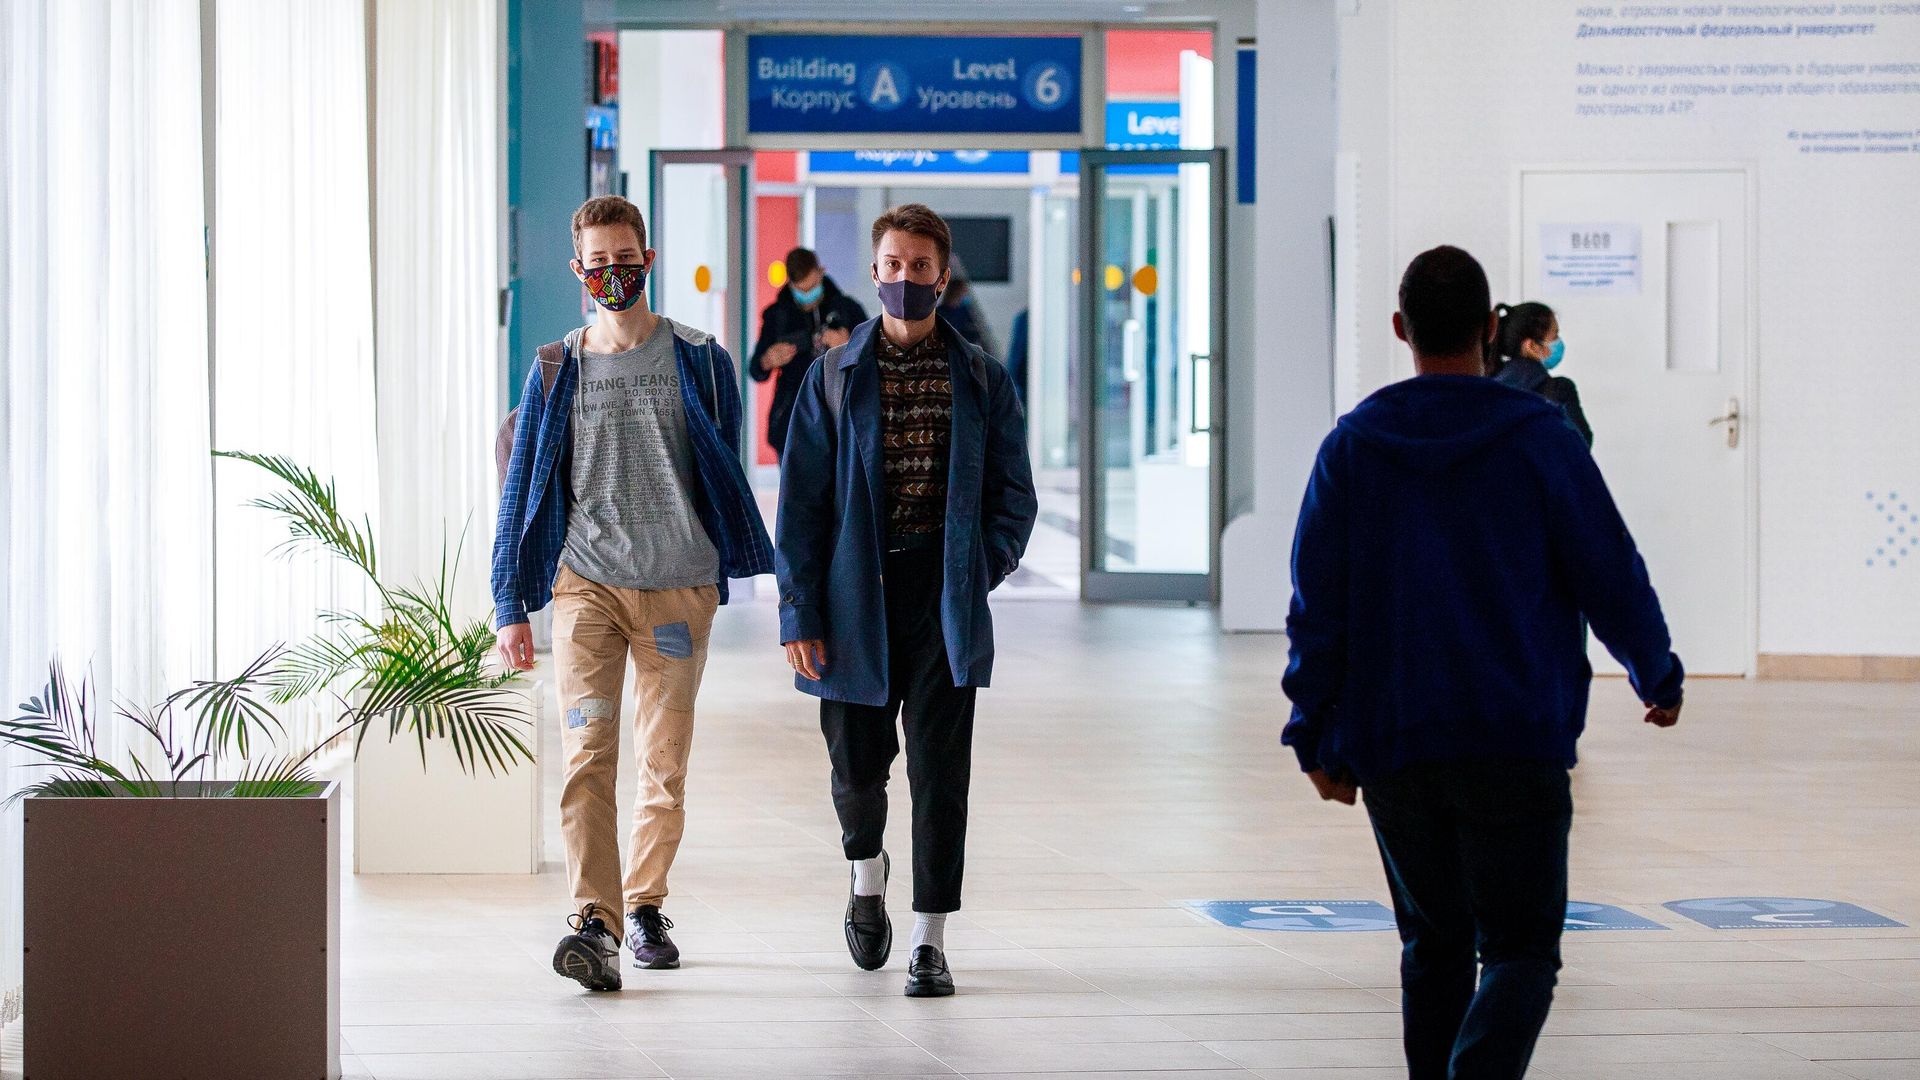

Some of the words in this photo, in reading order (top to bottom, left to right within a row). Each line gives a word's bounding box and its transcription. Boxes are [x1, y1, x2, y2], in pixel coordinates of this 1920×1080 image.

[1701, 22, 1792, 37] федеральный
[758, 56, 857, 85] Building
[952, 56, 1017, 81] Level
[869, 65, 901, 104] A
[1034, 66, 1062, 105] 6
[770, 86, 857, 114] Корпус
[916, 86, 1018, 114] Уровень
[624, 388, 641, 398] P.O.
[645, 387, 663, 397] BOX
[666, 388, 678, 398] 32
[631, 374, 678, 388] JEANS
[620, 407, 645, 418] TOWN
[624, 399, 634, 408] AT
[639, 397, 660, 406] 10TH
